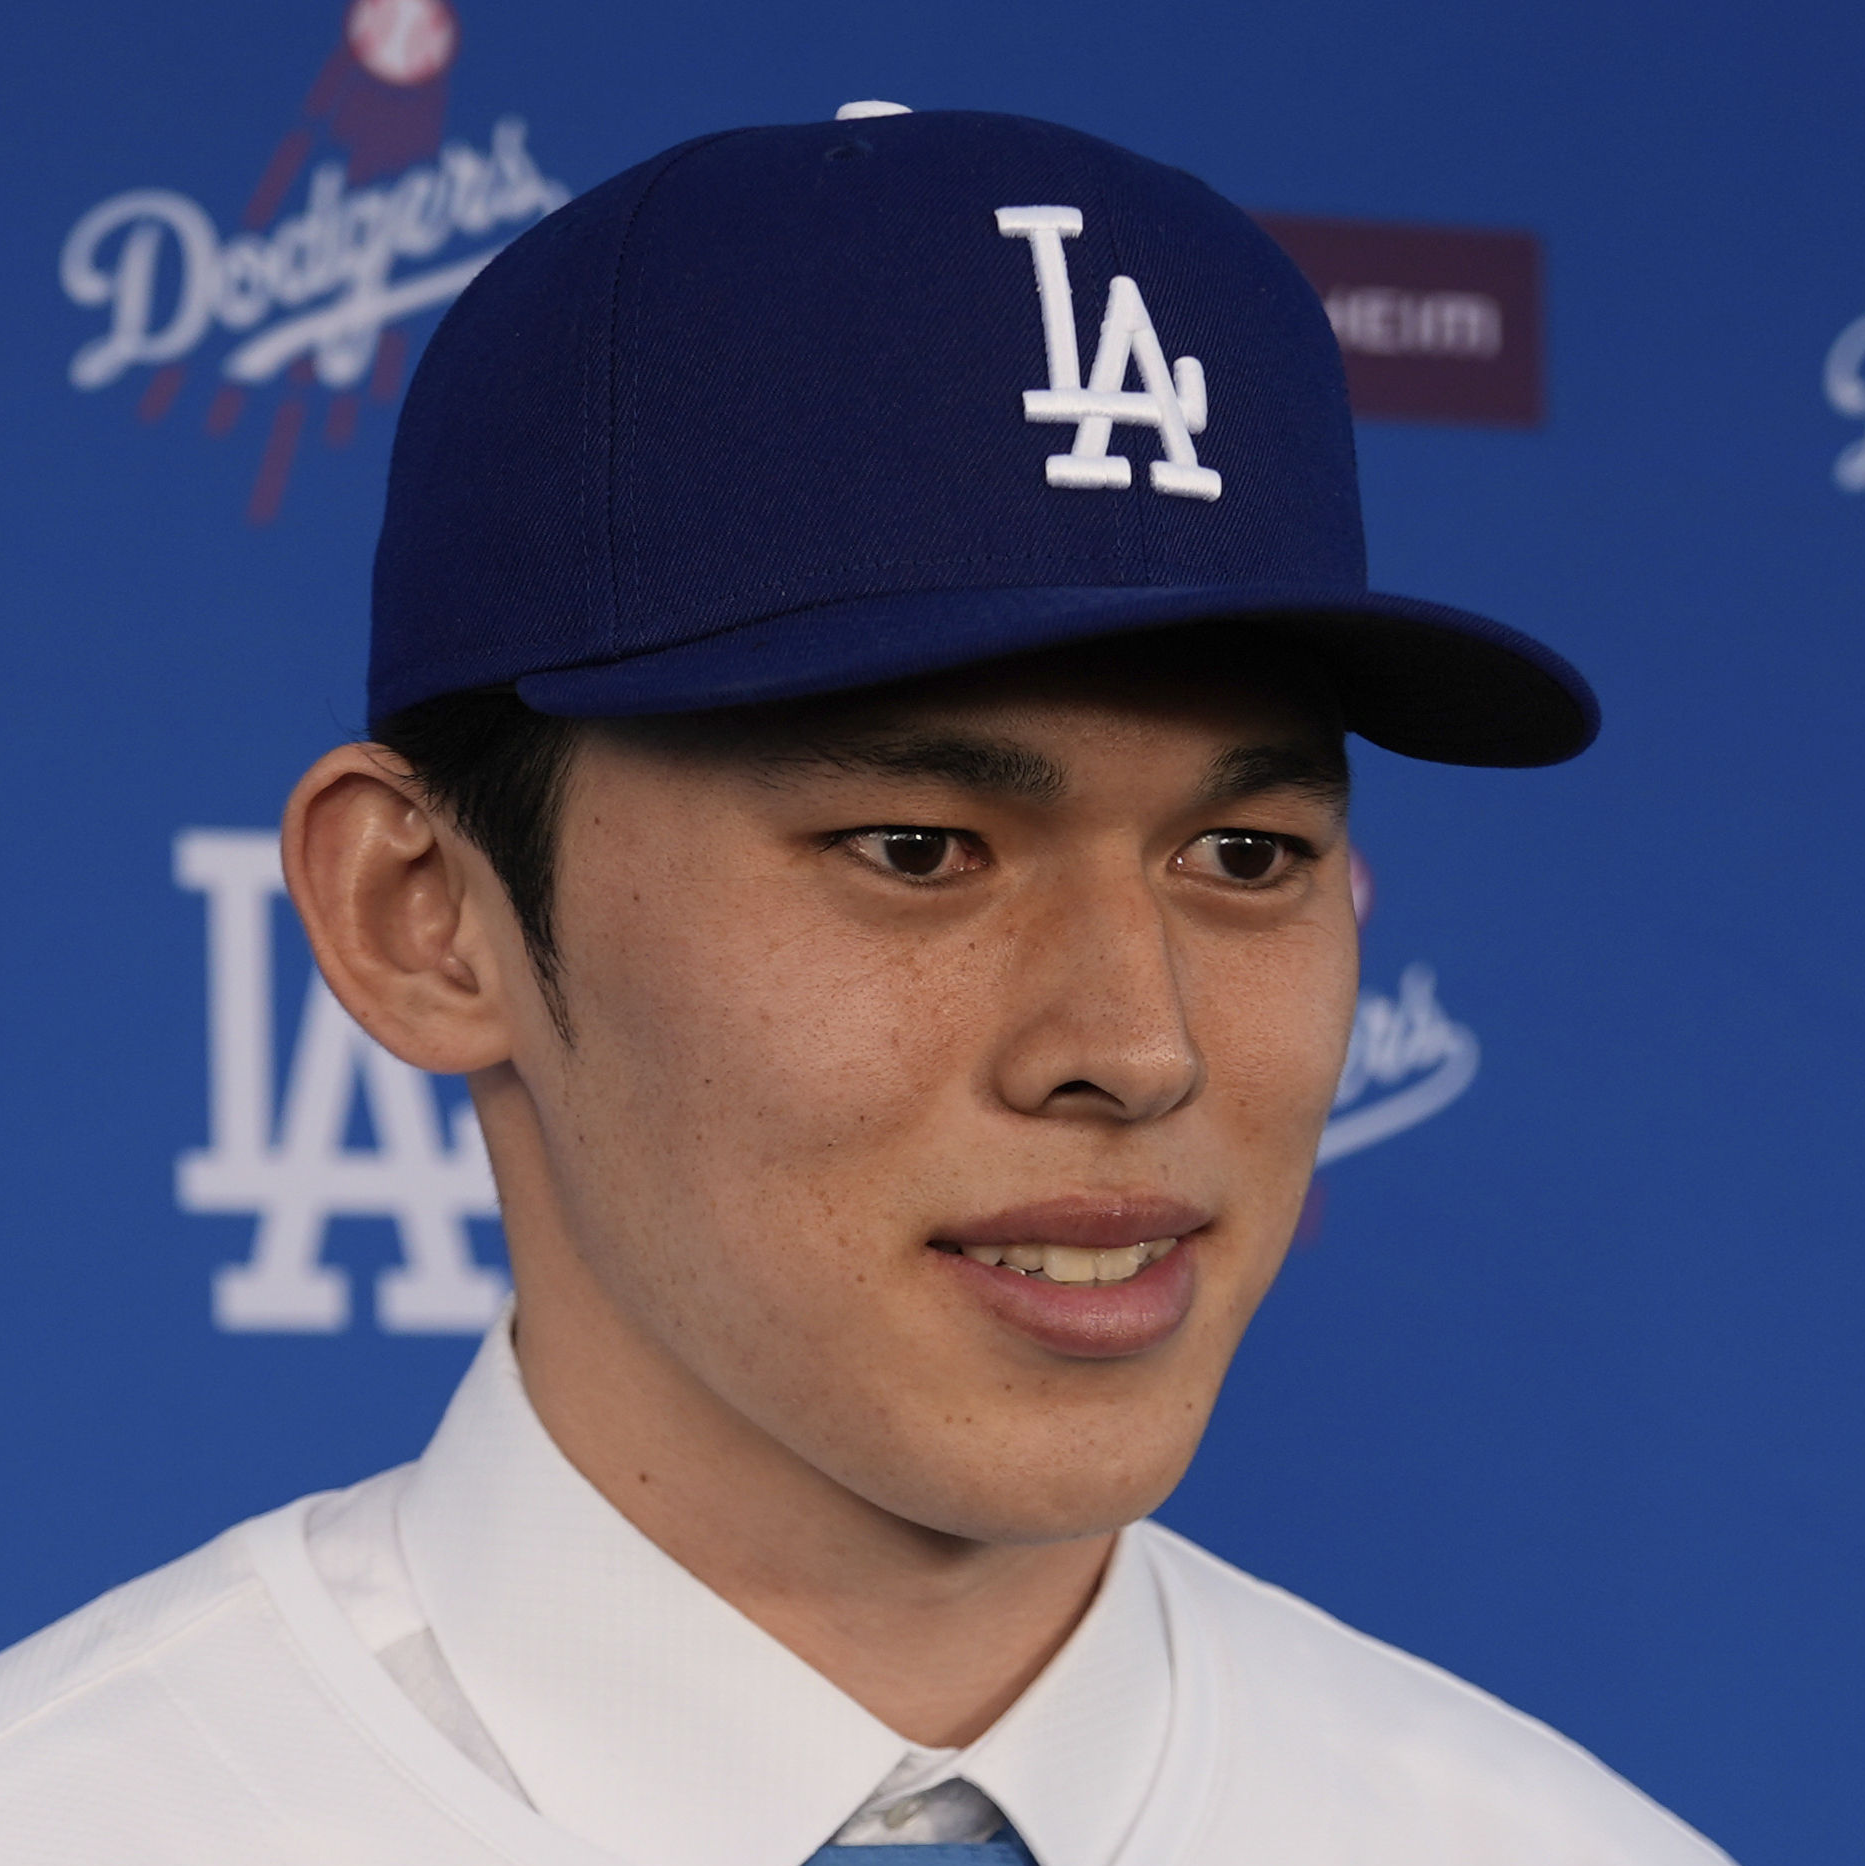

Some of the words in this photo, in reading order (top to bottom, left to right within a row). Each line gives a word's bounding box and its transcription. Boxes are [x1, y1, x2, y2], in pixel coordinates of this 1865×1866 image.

[59, 118, 571, 390] Dodgers
[995, 206, 1222, 500] LA
[174, 830, 516, 1335] LA
